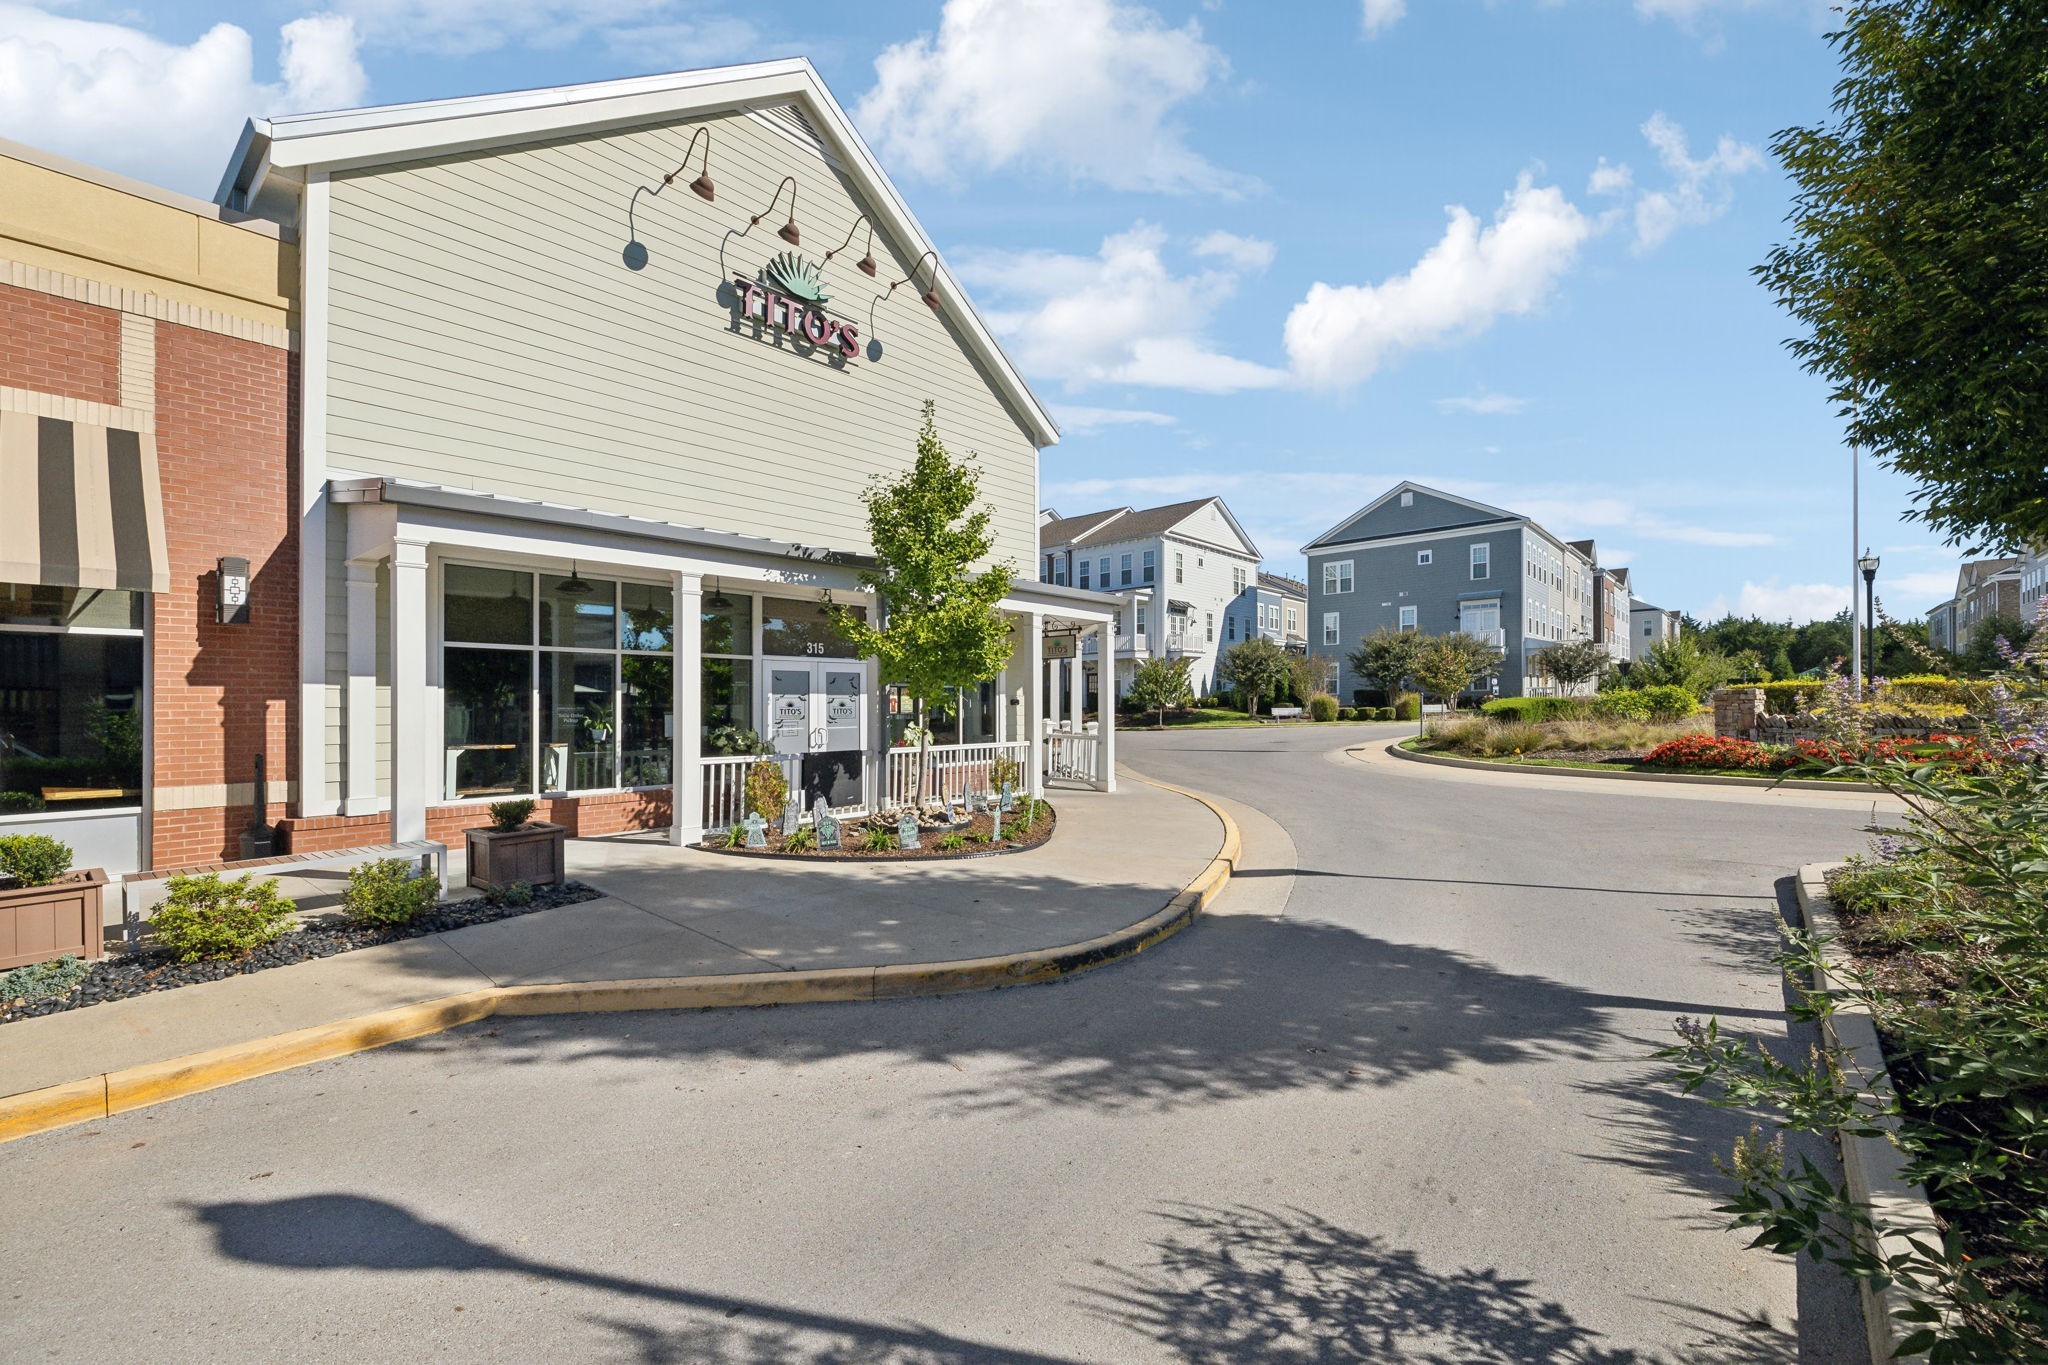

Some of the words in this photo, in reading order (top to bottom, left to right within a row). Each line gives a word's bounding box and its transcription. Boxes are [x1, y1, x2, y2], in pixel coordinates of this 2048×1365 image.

[735, 279, 860, 359] TITO'S
[806, 642, 824, 654] 315
[832, 707, 853, 715] TITO'S
